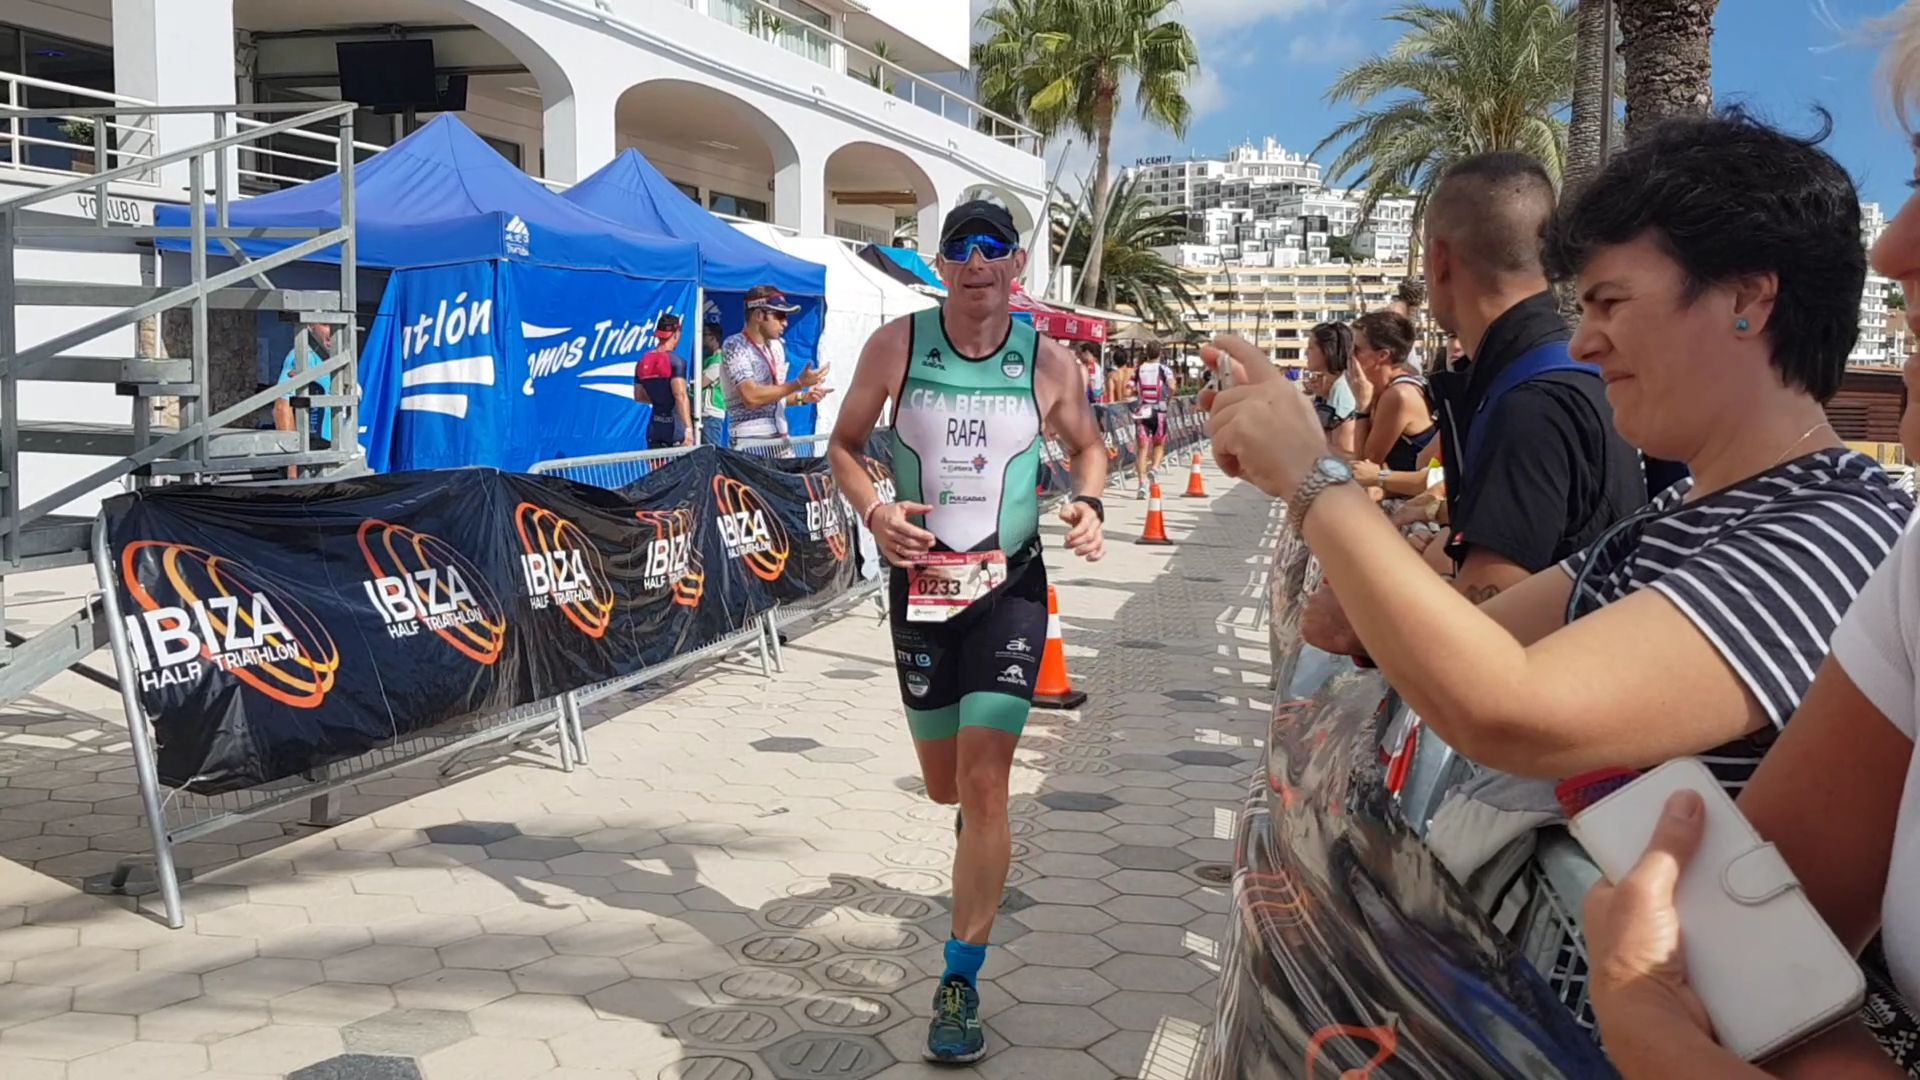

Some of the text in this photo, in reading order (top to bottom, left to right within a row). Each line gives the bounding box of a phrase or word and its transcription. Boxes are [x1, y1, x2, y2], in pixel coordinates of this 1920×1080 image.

[77, 195, 141, 222] YOUBO
[589, 305, 685, 361] Triatl
[910, 388, 1029, 416] CEA BÉTERA
[946, 417, 987, 447] RAFA
[716, 509, 770, 549] IBIZA
[520, 549, 592, 597] IBIZA
[644, 575, 666, 590] HALF
[918, 579, 962, 596] 0233
[363, 565, 478, 624] IBIZA
[529, 595, 550, 610] HALF
[124, 592, 295, 673] IBIZA
[387, 607, 484, 640] HALF TRIATHLON
[210, 641, 300, 672] TRIATHLON
